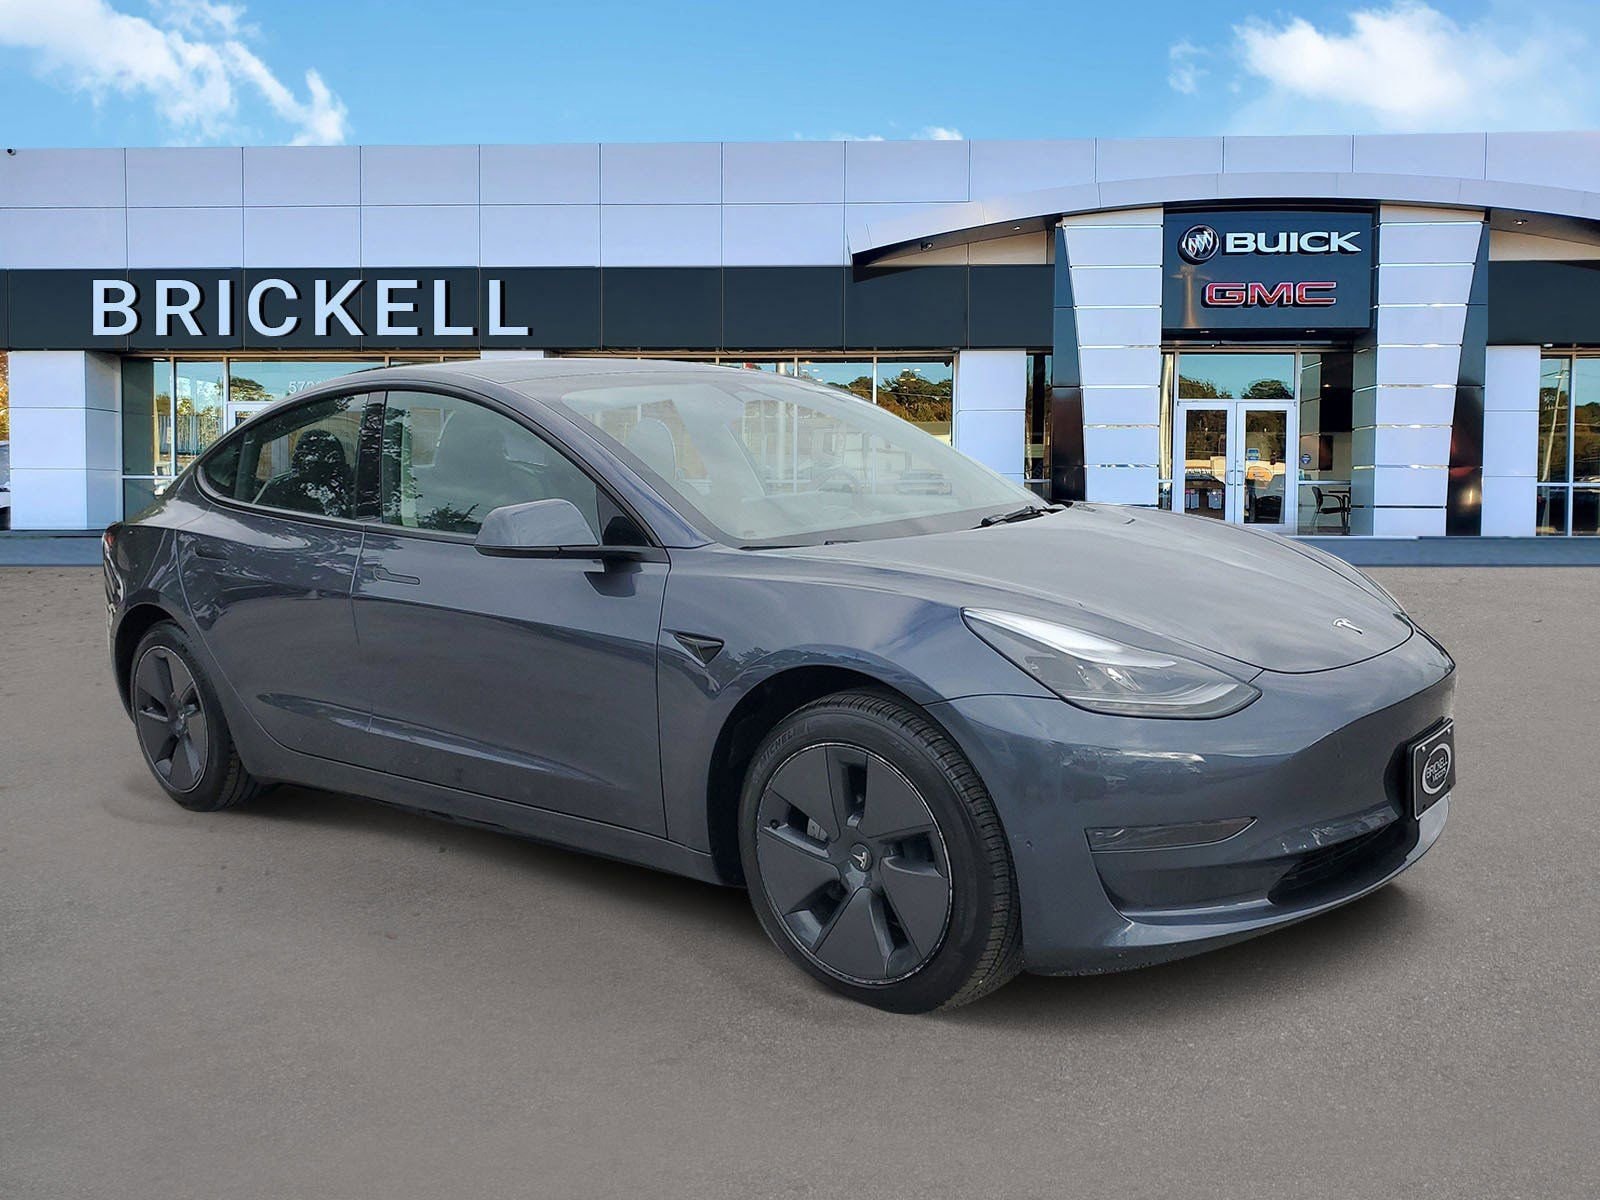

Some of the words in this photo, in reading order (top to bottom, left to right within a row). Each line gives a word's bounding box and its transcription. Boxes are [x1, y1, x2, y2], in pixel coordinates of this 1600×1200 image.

[1226, 231, 1362, 252] BUICK
[1206, 282, 1337, 305] GMC
[92, 278, 531, 337] BRICKELL
